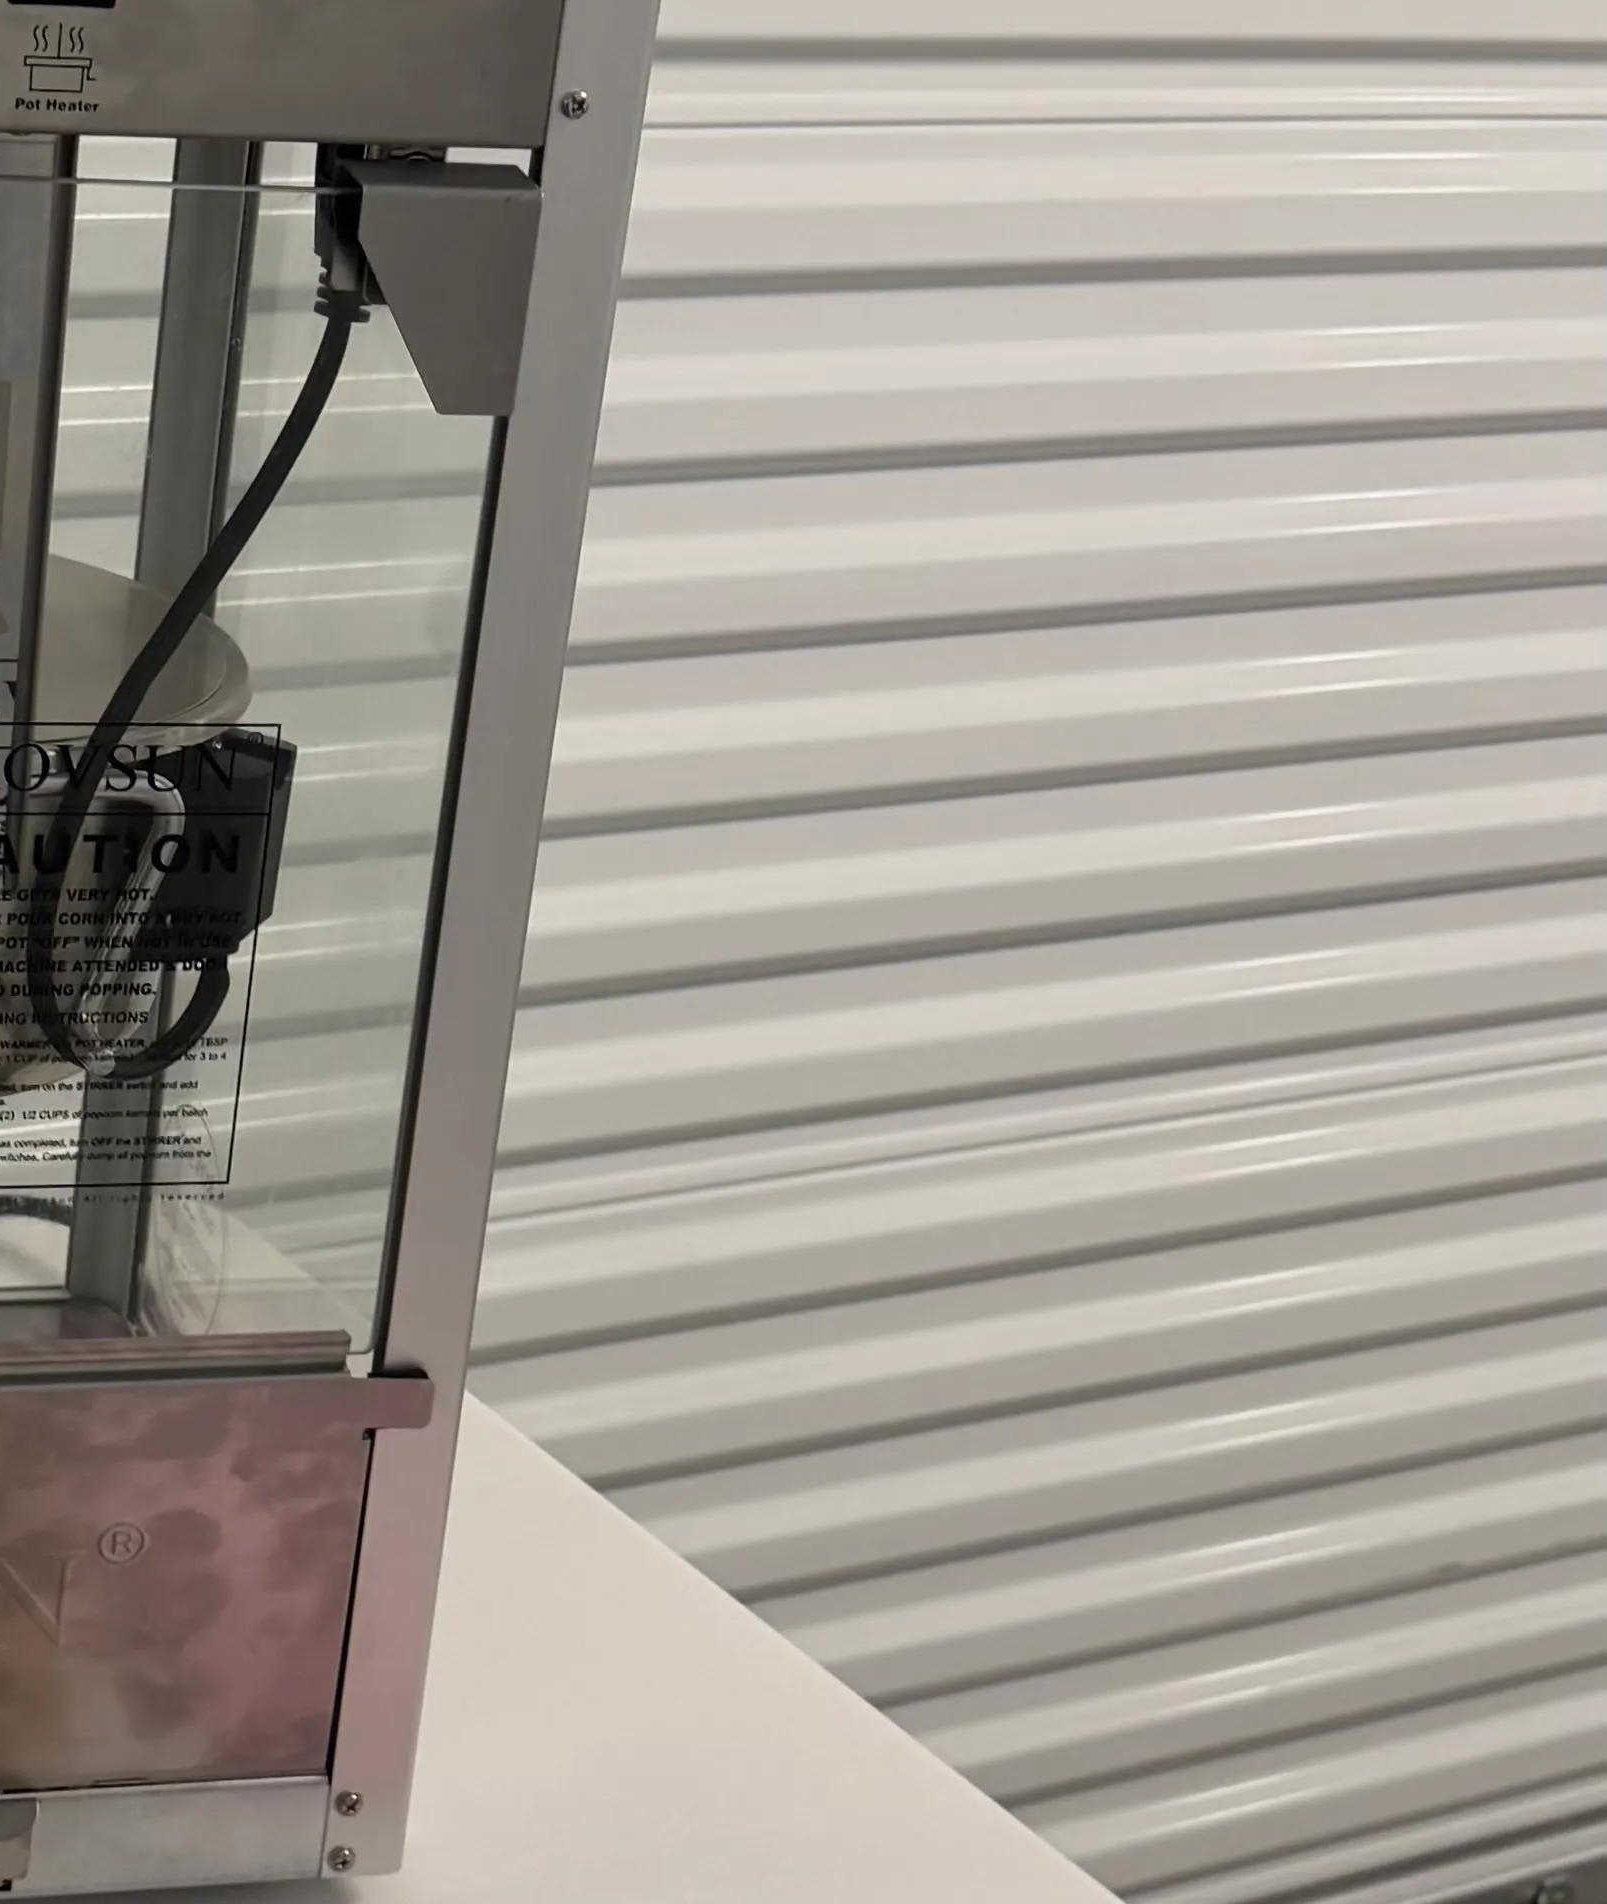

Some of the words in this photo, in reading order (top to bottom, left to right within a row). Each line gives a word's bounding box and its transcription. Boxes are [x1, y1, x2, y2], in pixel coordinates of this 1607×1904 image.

[14, 96, 42, 112] Pot
[46, 98, 100, 114] Heater
[66, 887, 112, 902] VERY
[7, 911, 52, 926] POUR
[57, 911, 106, 926] CORN
[109, 909, 151, 925] INTO
[84, 934, 133, 949] WHEN
[71, 957, 162, 973] ATTENDED
[10, 982, 77, 997] DURING
[80, 981, 157, 997] POPPING.
